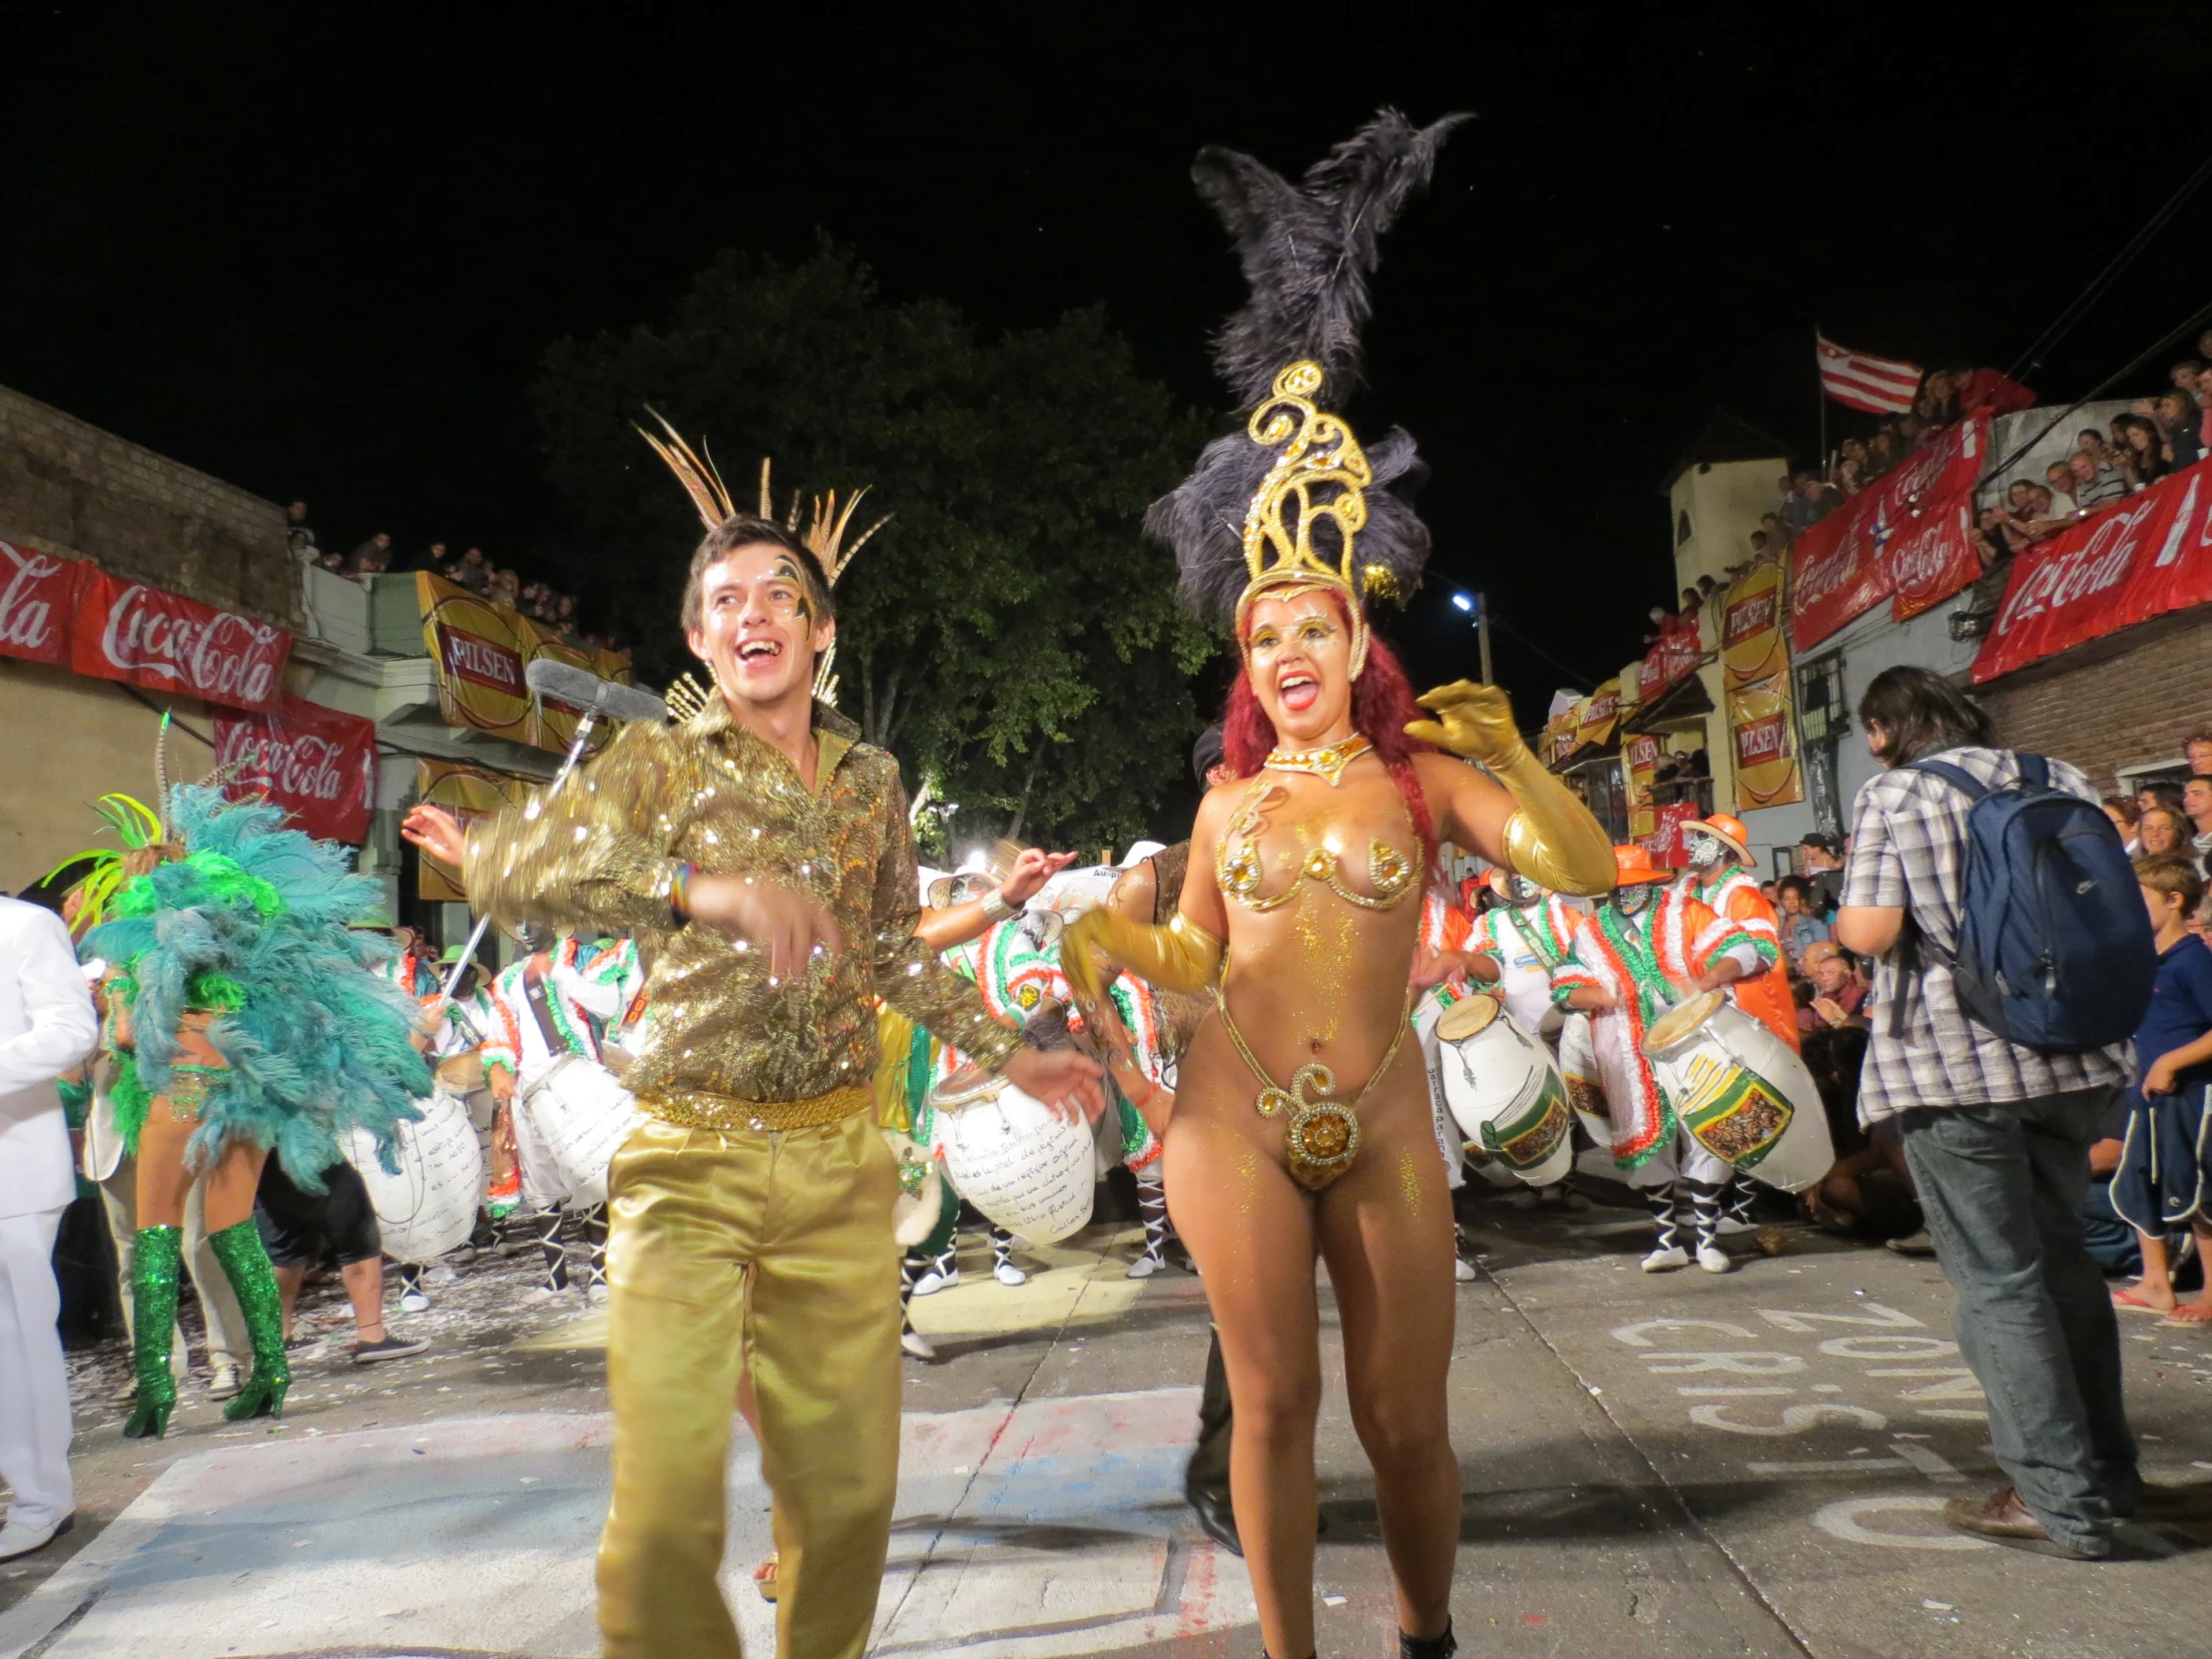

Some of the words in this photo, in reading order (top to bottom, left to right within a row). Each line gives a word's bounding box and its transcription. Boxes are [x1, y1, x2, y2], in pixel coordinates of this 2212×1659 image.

[1998, 497, 2158, 636] Coca-Cola
[103, 585, 280, 703] Coca-Cola
[449, 636, 516, 686] PILSEN
[224, 719, 344, 800] Coca-Cola
